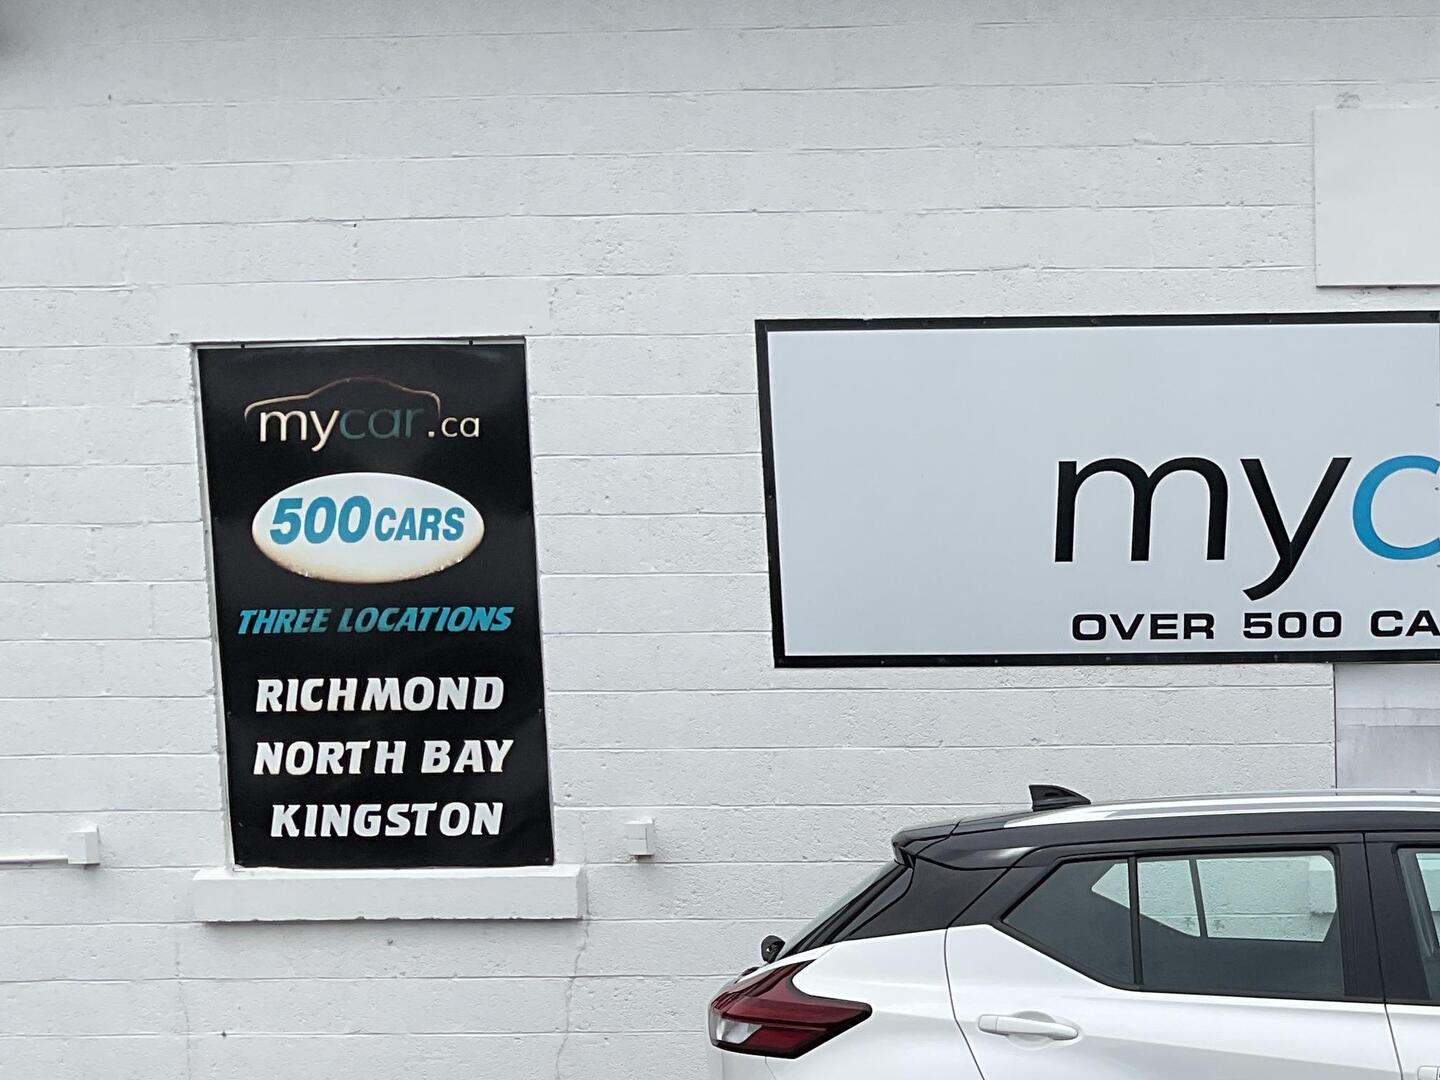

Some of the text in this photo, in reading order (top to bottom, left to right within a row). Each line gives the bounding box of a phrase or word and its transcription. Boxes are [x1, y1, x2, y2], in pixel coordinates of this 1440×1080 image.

[259, 404, 480, 451] mycar.ca
[270, 496, 465, 544] 500 CARS
[238, 607, 514, 634] THREE LOCATIONS
[1072, 613, 1214, 641] OVER
[1243, 610, 1342, 639] 500
[255, 676, 503, 713] RICHMOND
[253, 739, 513, 775] NORTH BAY
[270, 803, 503, 837] KINGSTON
